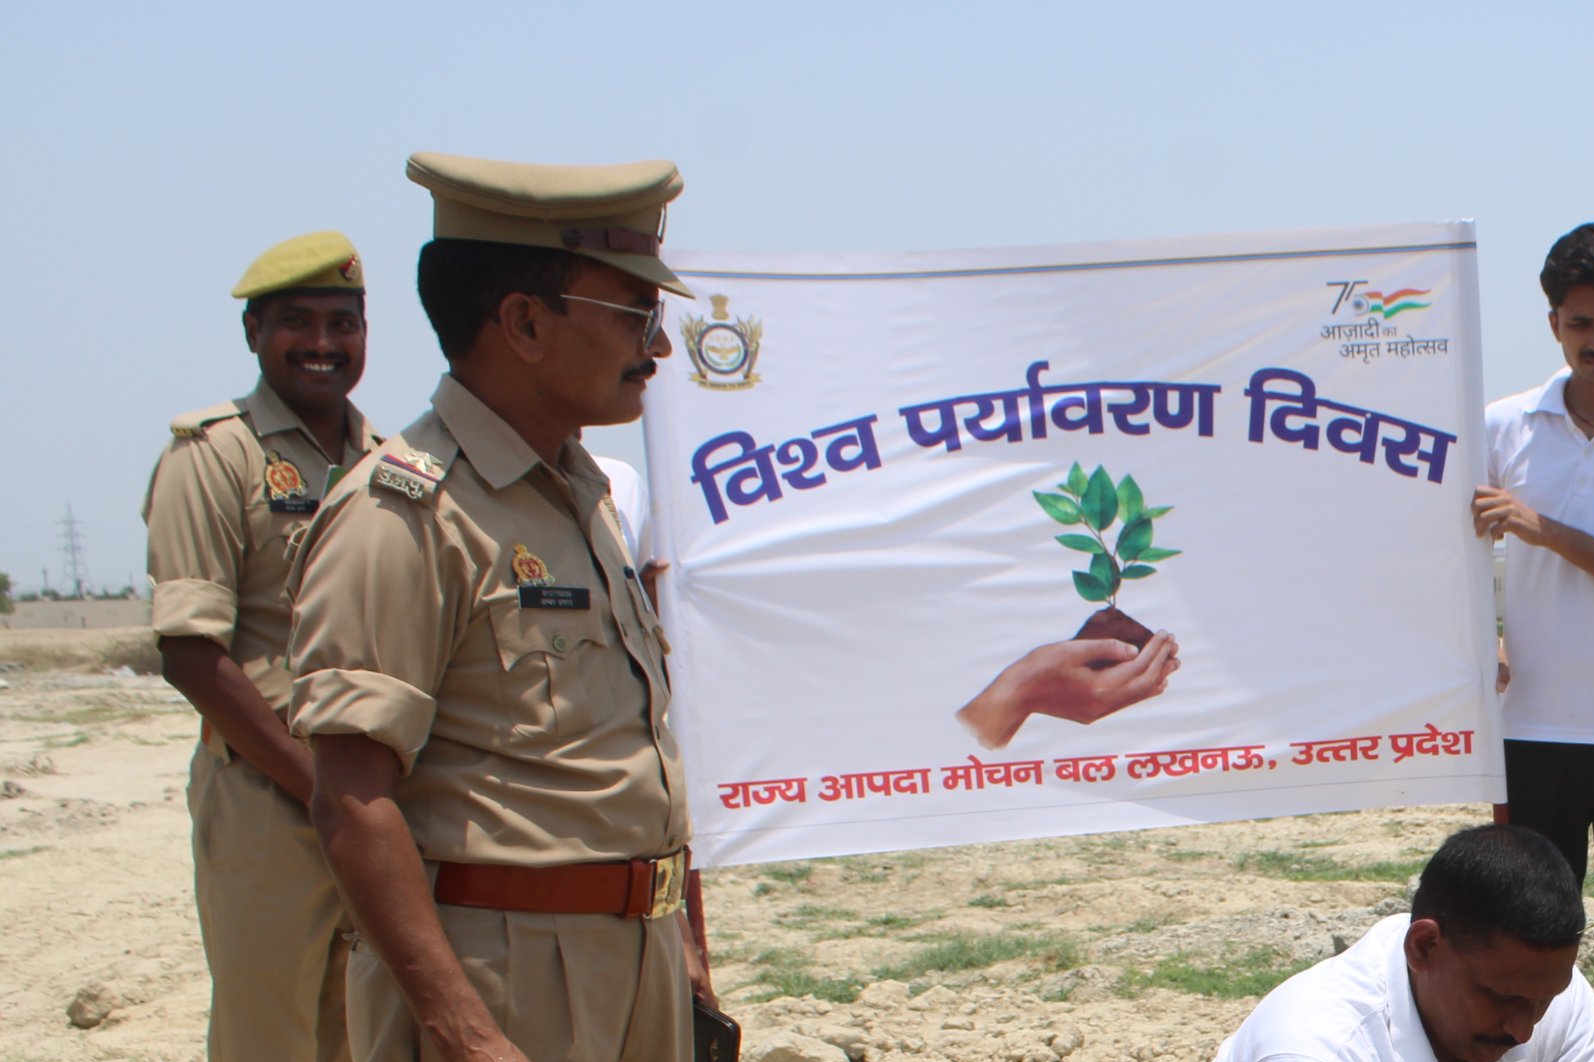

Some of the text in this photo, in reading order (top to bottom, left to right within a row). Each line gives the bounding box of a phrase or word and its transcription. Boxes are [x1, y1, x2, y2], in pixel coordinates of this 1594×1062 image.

[1339, 334, 1449, 364] अमृत महोत्सव
[1381, 325, 1398, 337] का
[690, 360, 1458, 524] विश्व पर्यावरण दिवस
[719, 722, 1475, 810] राज्य आपदा मोचन बल लखनऊ, उत्तर प्रदेश
